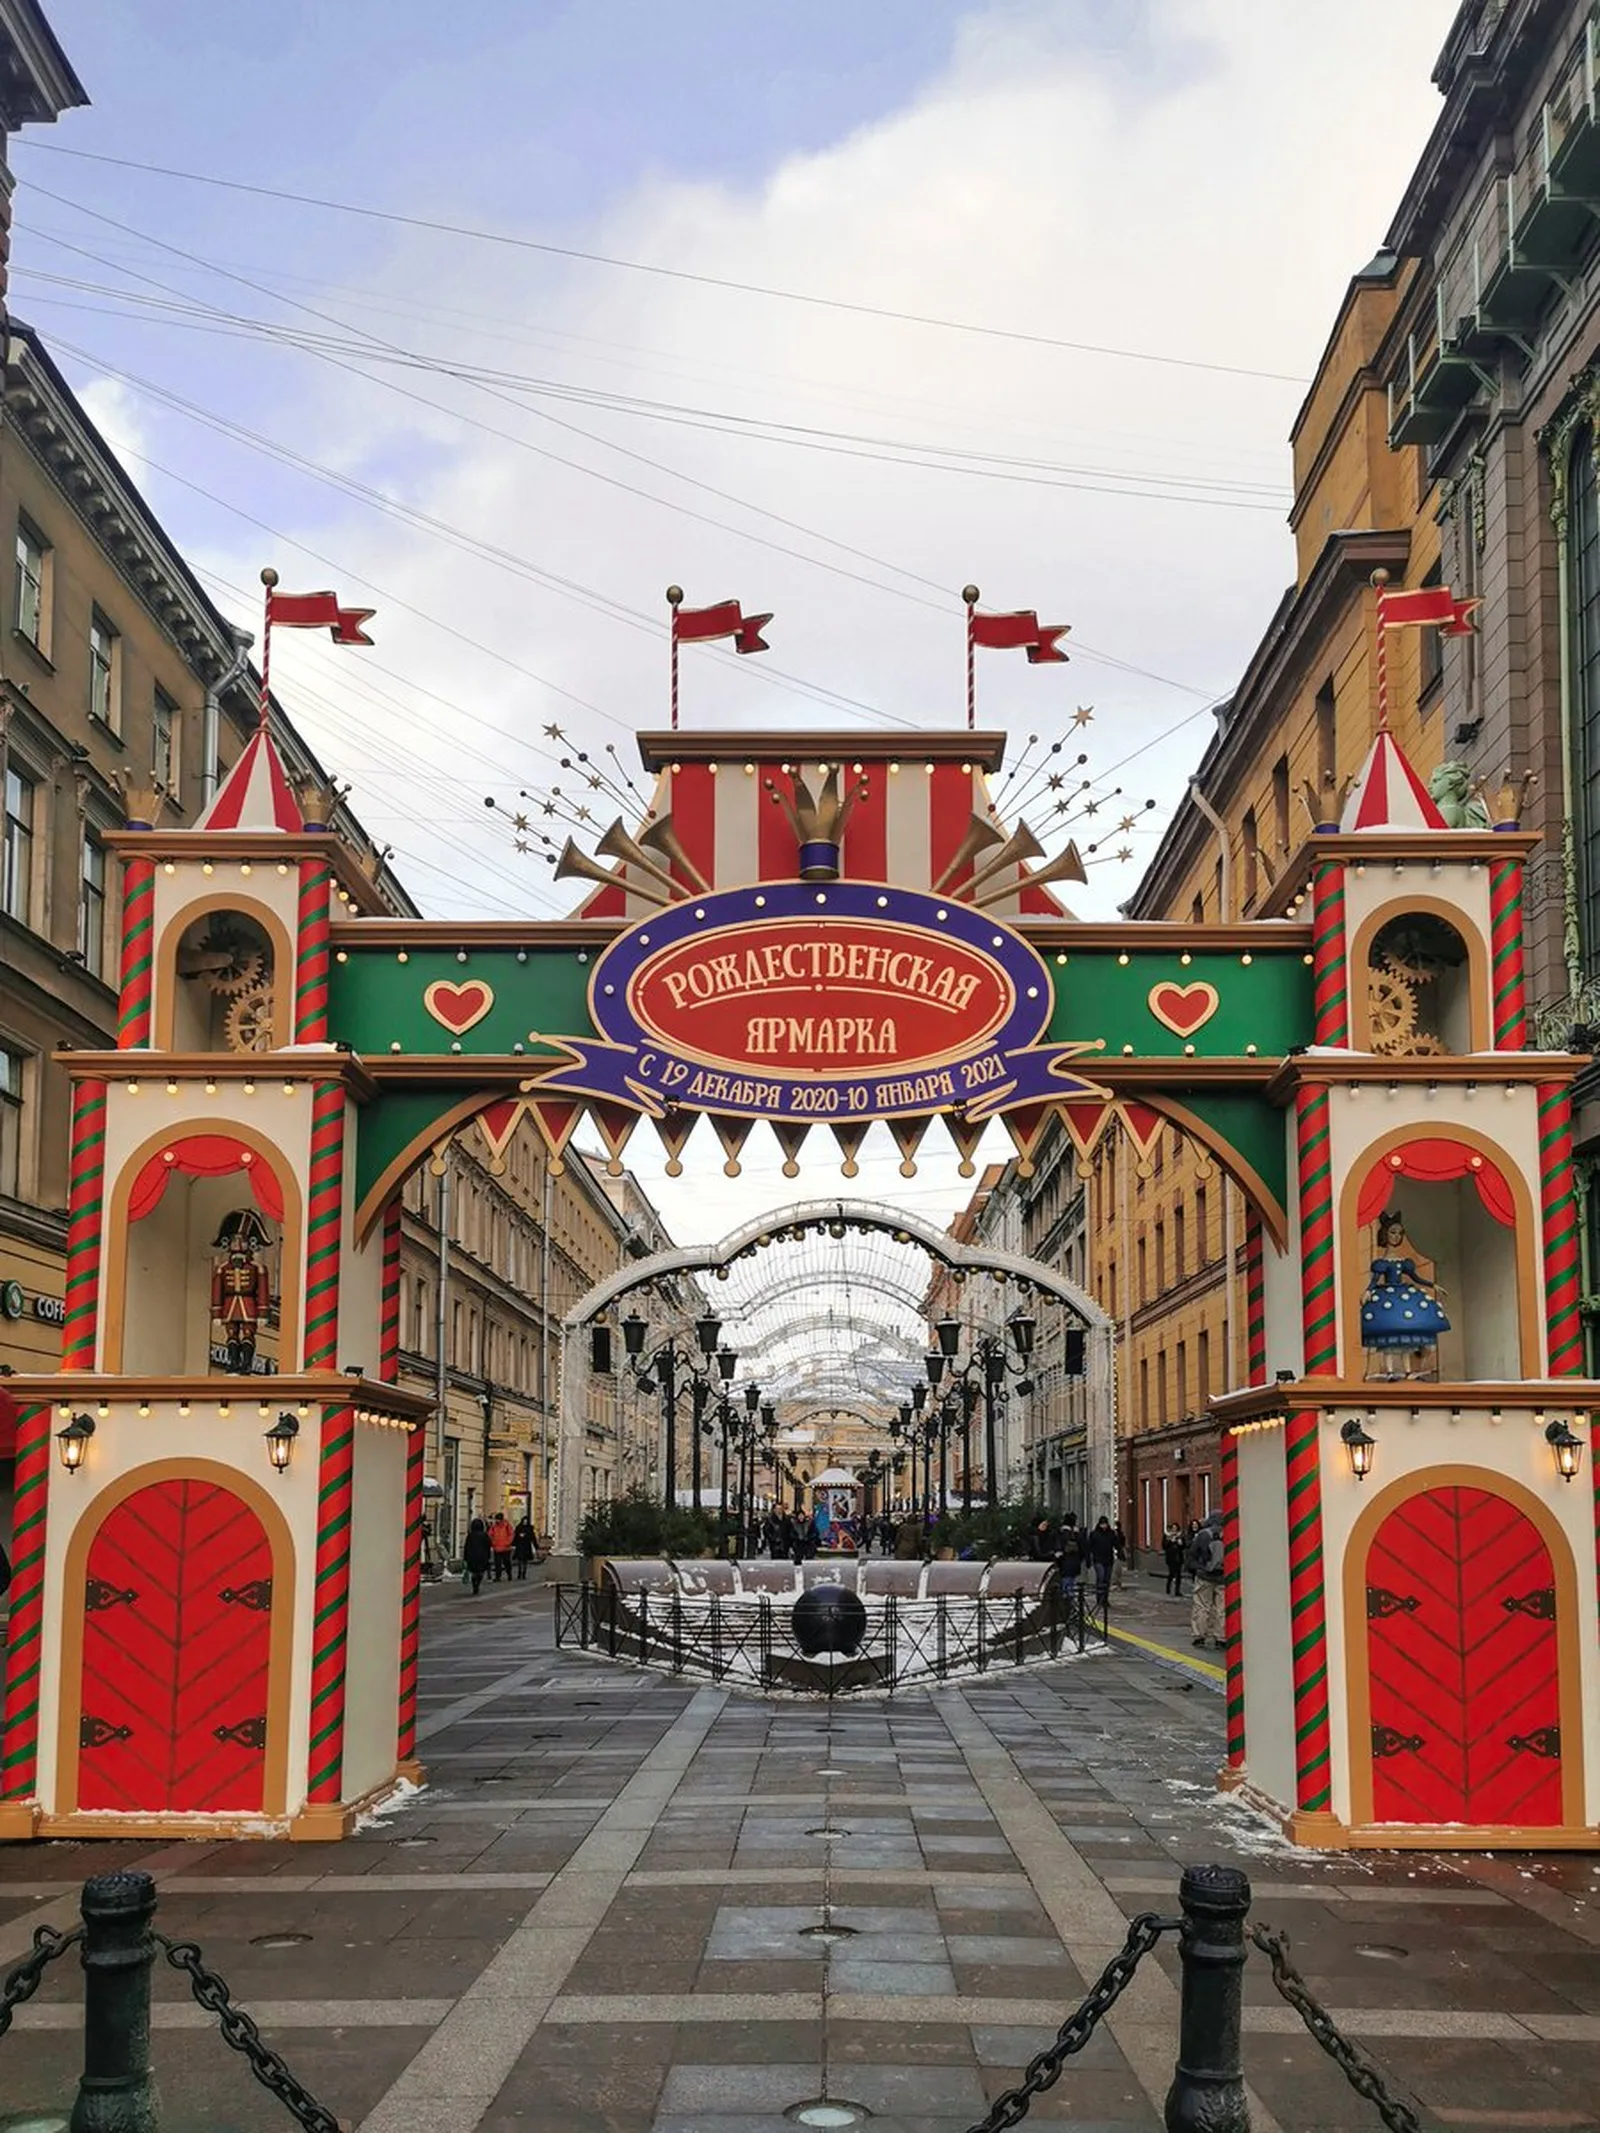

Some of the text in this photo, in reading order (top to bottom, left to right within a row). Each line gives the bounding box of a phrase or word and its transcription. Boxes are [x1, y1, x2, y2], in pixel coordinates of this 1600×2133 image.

[661, 942, 982, 1010] РОЖДЕСТВЕНСКАЯ
[745, 1017, 898, 1054] ЯРМАРКА
[638, 1053, 657, 1077] С
[659, 1060, 690, 1086] 19
[686, 1071, 783, 1109] ДЕКАБРЯ
[875, 1070, 956, 1109] ЯНВАРЯ
[960, 1052, 1008, 1089] 2021
